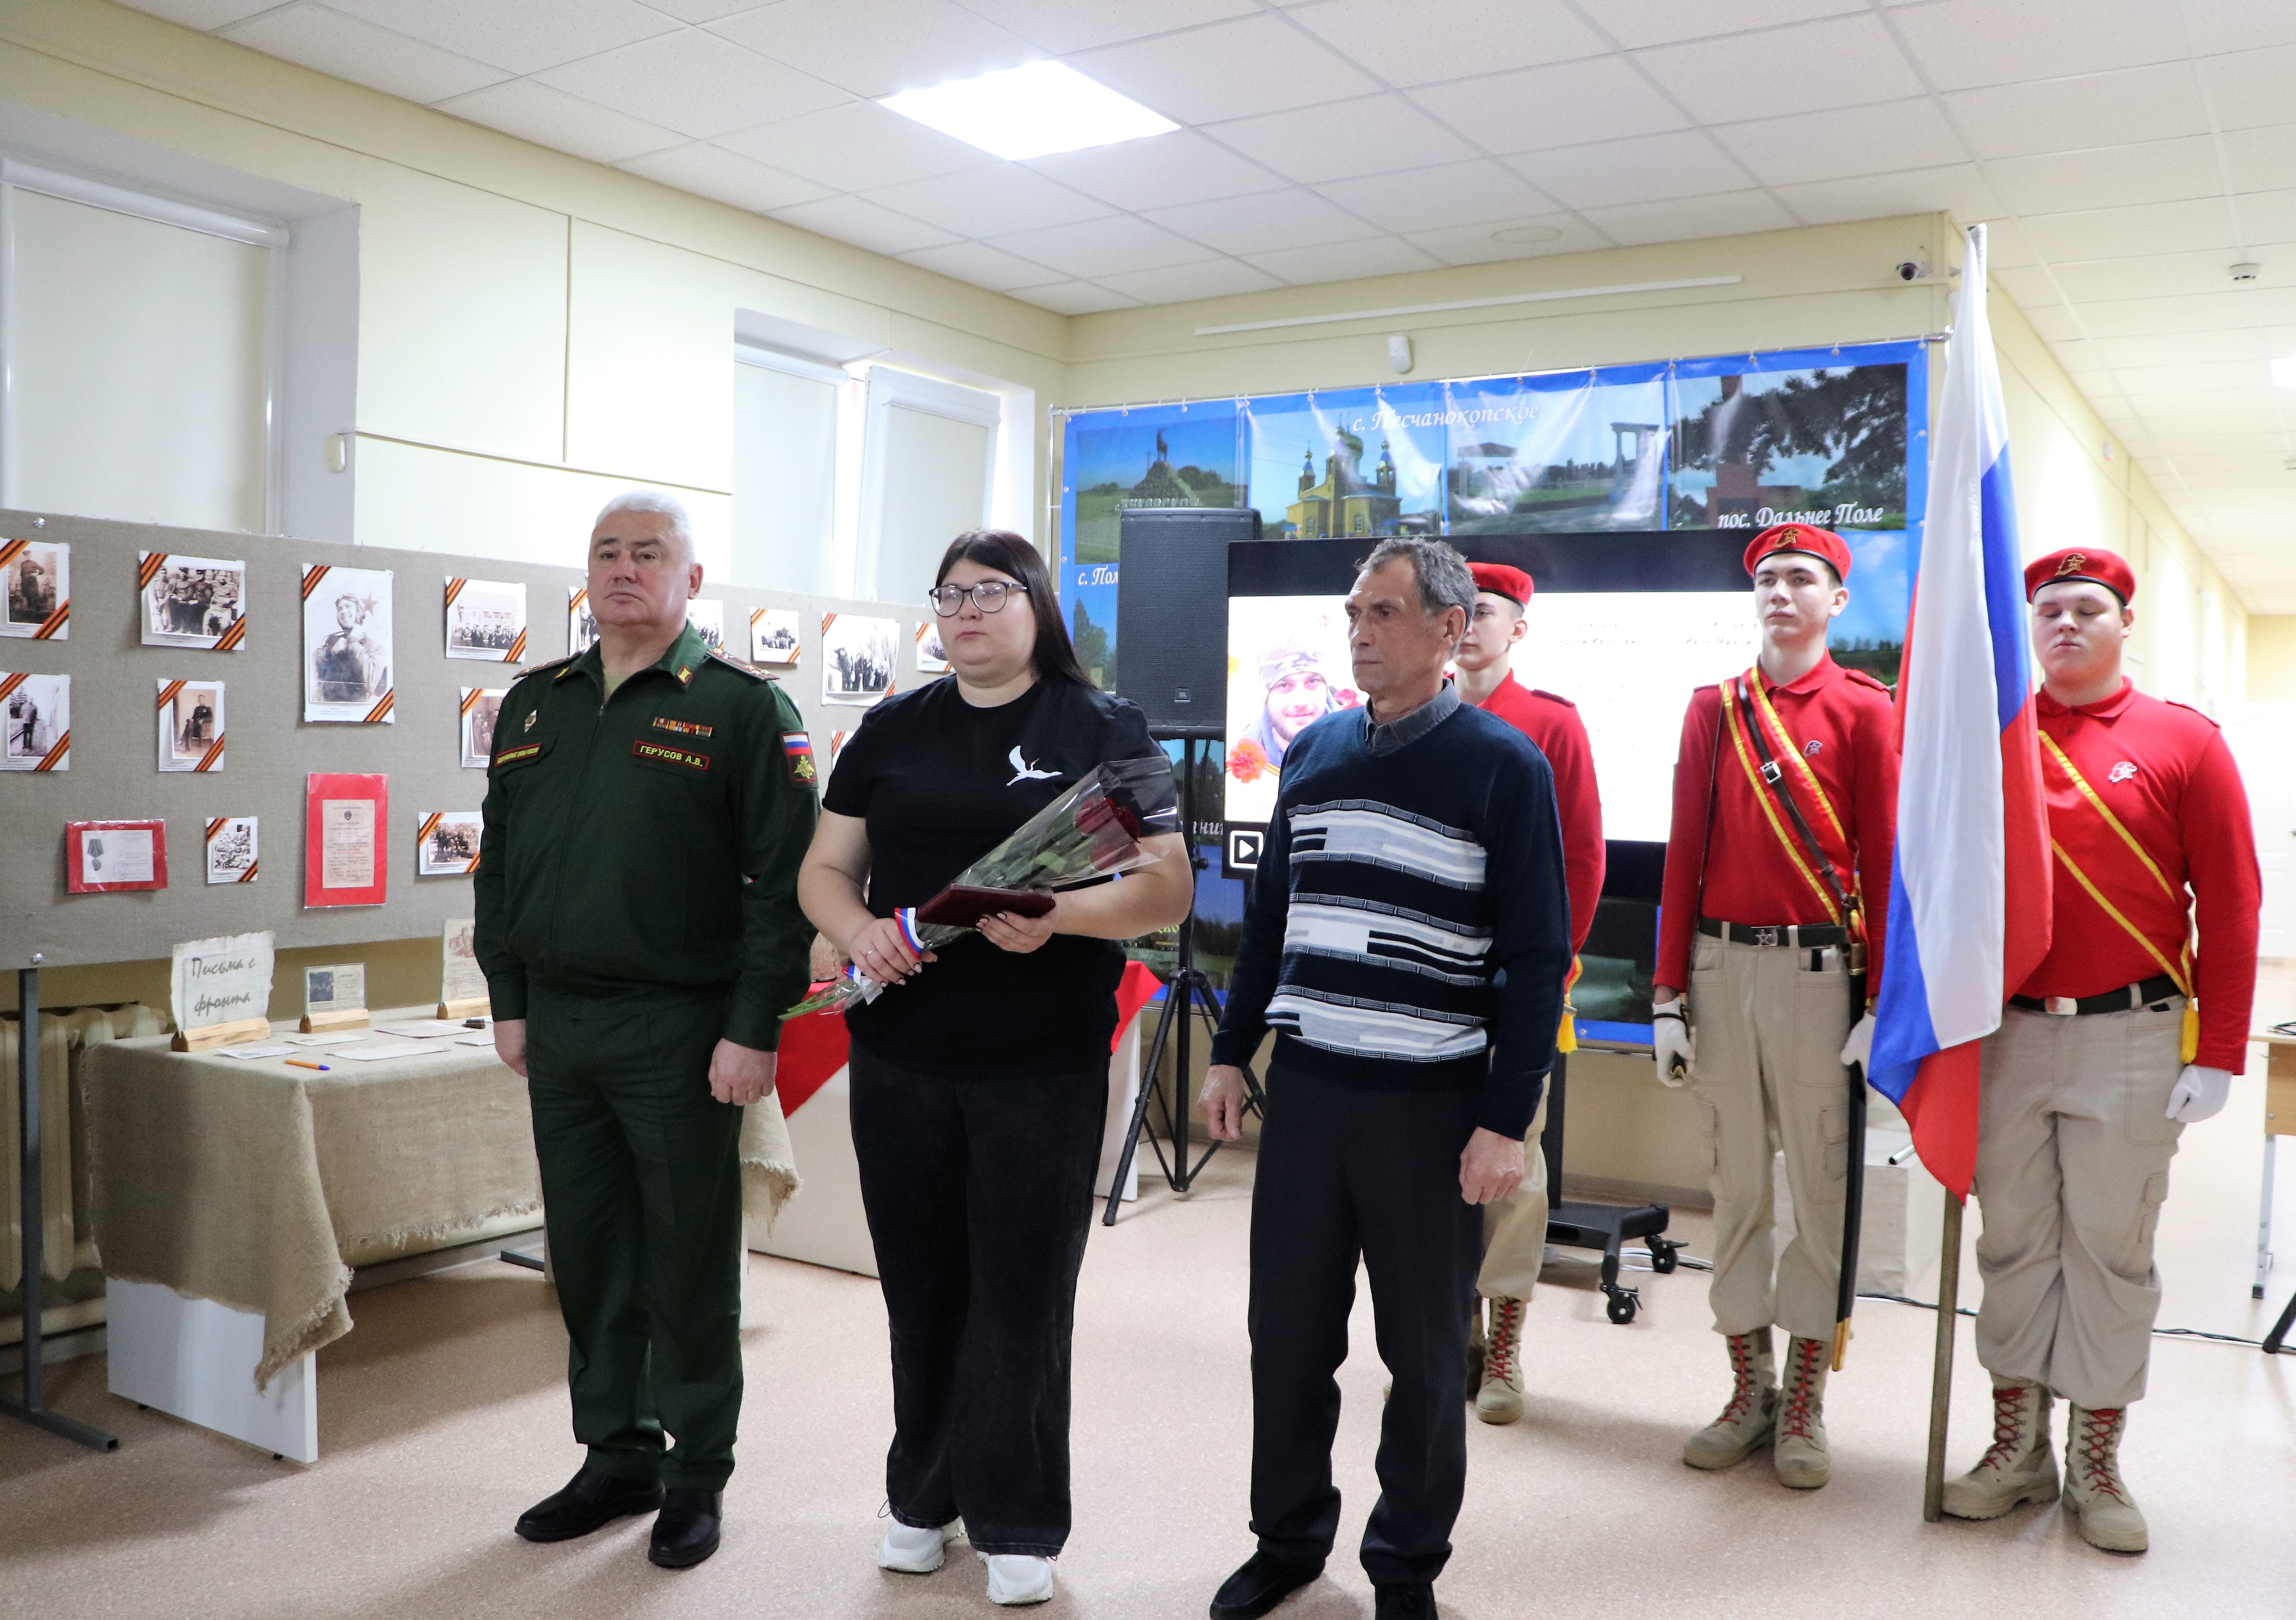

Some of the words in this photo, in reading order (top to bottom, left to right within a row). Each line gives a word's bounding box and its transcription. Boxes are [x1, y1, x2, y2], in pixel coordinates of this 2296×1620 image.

[1352, 417, 1365, 431] с.
[1370, 405, 1540, 430] Песчанокопское
[1717, 513, 1751, 529] пос.
[1755, 506, 1831, 527] Дальнее
[1834, 500, 1885, 525] Поле
[1078, 572, 1088, 585] с.
[1091, 565, 1118, 585] Пол
[639, 745, 683, 760] ГЕРУСОВ
[685, 755, 703, 767] А.В.
[192, 957, 244, 979] Письма
[249, 957, 256, 968] с
[194, 992, 251, 1017] фронта
